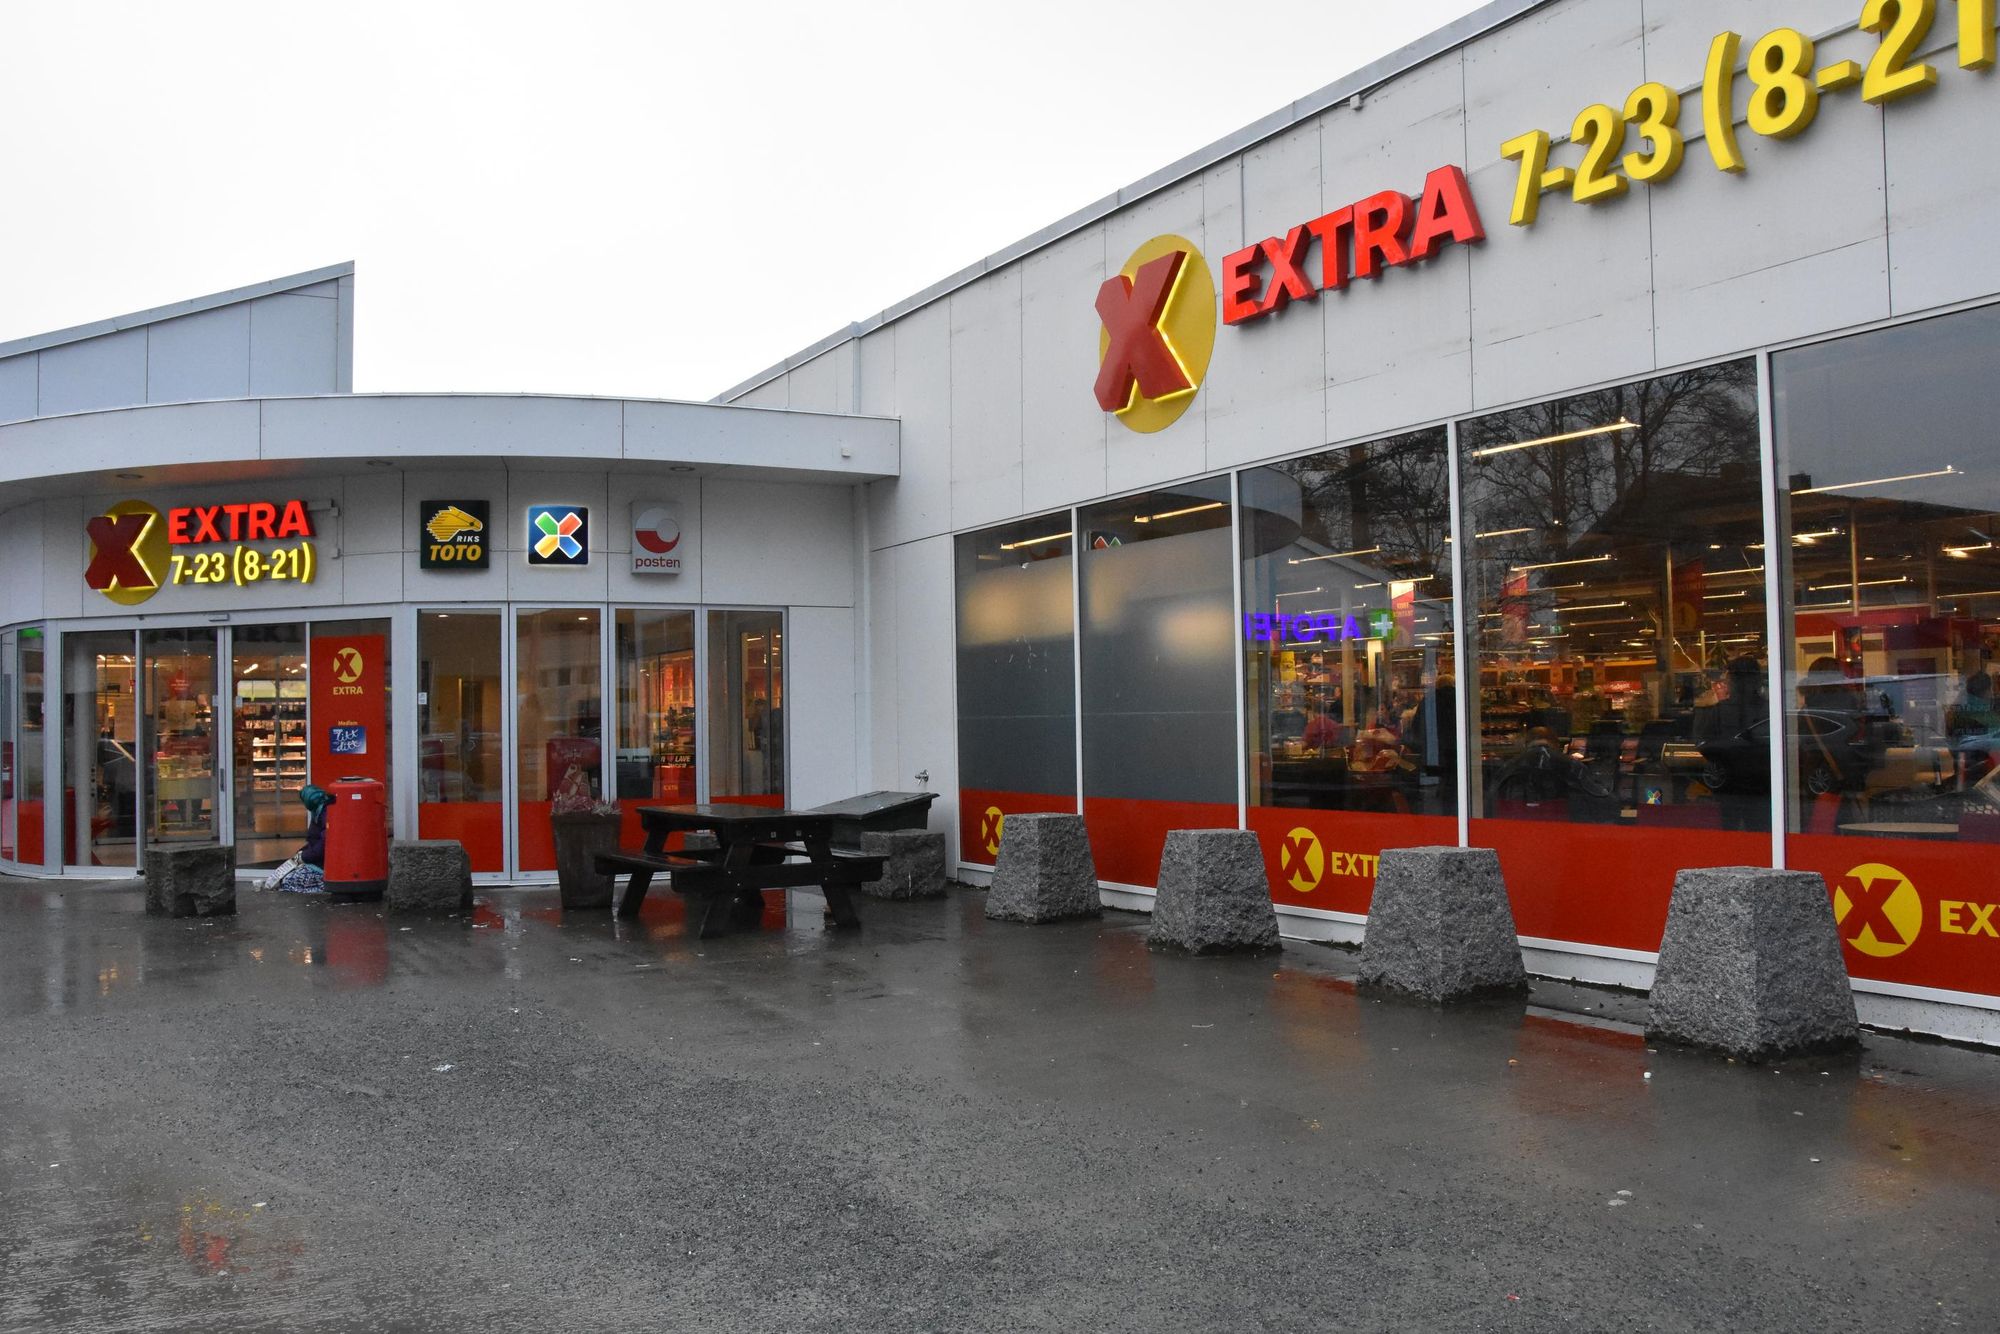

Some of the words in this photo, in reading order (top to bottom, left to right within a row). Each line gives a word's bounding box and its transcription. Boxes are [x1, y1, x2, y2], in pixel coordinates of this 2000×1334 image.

[1222, 164, 1486, 327] EXTRA
[1500, 81, 1685, 228] 7-23
[167, 499, 315, 545] EXTRA
[429, 544, 483, 561] TOTO
[456, 534, 481, 543] RIKS
[171, 551, 228, 585] 7-23
[233, 541, 315, 587] (8-21)
[635, 555, 681, 570] posten
[333, 686, 364, 696] EXTRA
[1939, 899, 2000, 938] EX
